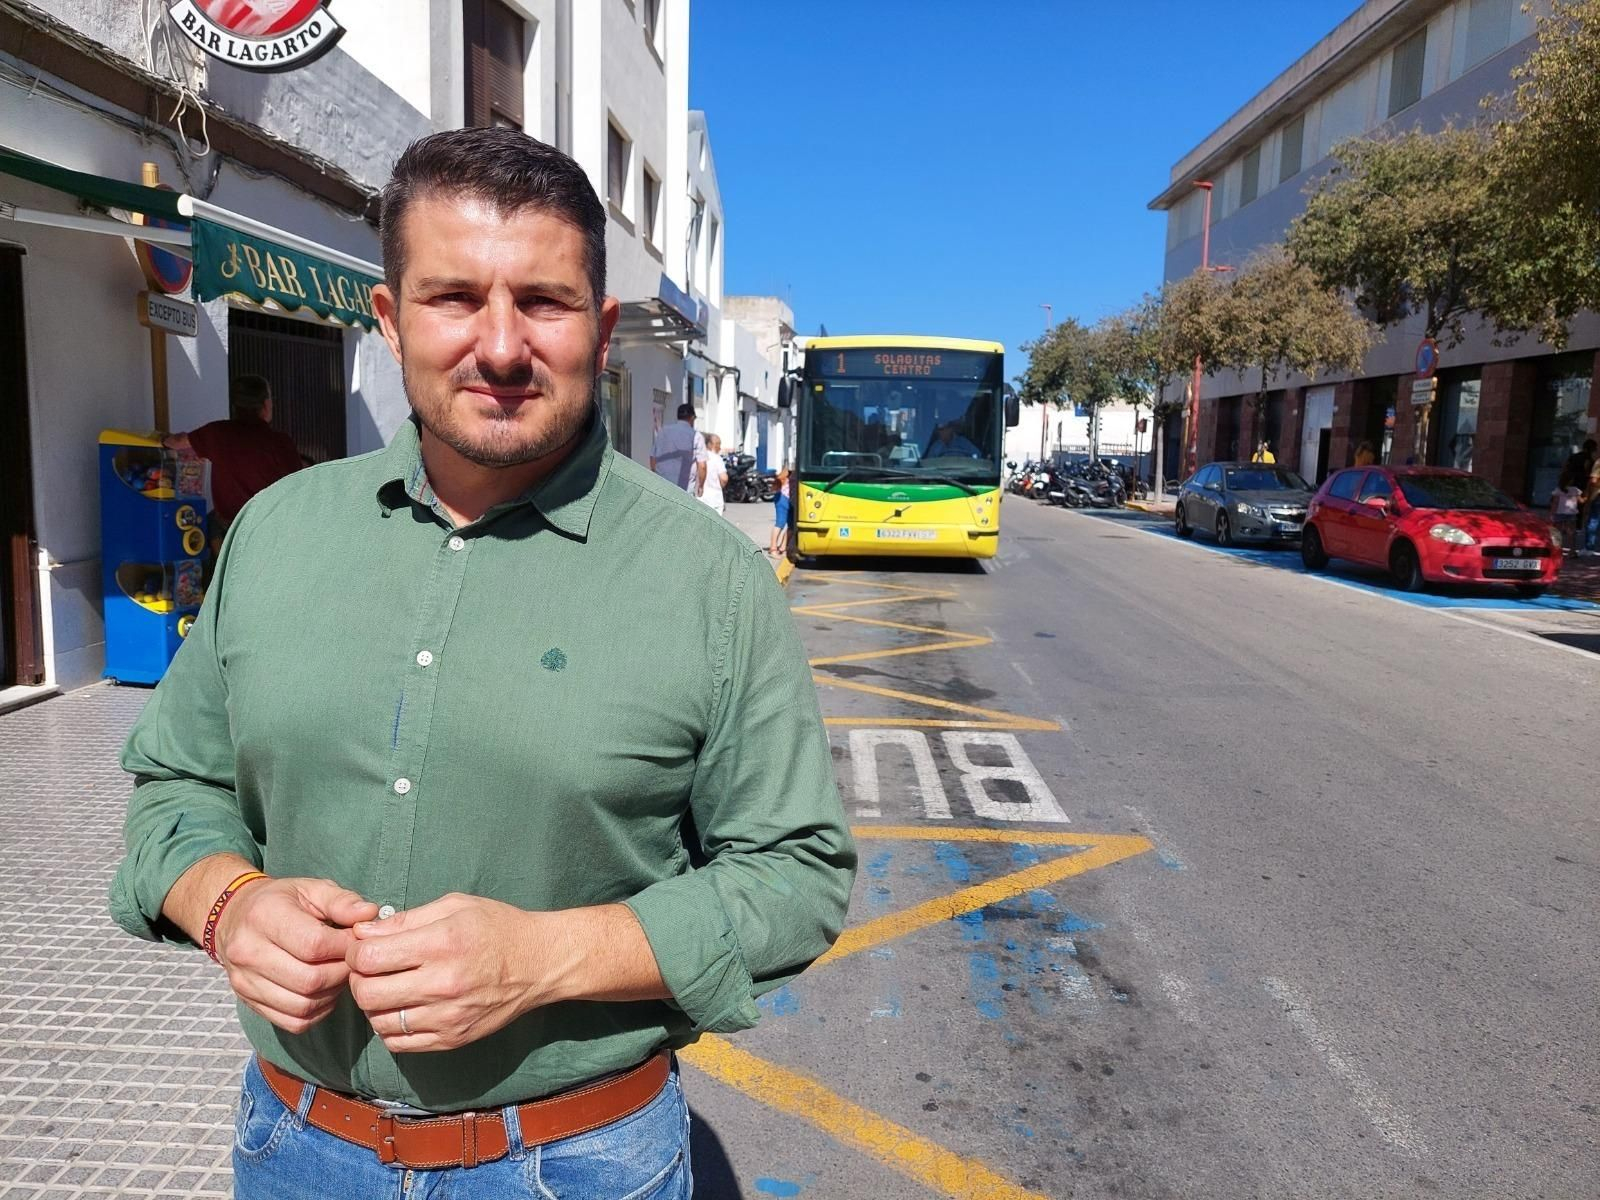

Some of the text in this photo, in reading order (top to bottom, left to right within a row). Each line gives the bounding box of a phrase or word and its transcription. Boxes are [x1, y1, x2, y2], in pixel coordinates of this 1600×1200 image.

[181, 9, 322, 61] BAR LAGARTO
[241, 243, 378, 319] BAR LAGAR
[149, 301, 196, 329] EXCEPTO BUS
[837, 352, 846, 373] 1
[883, 364, 931, 375] CENTRO
[827, 729, 1071, 823] BU
